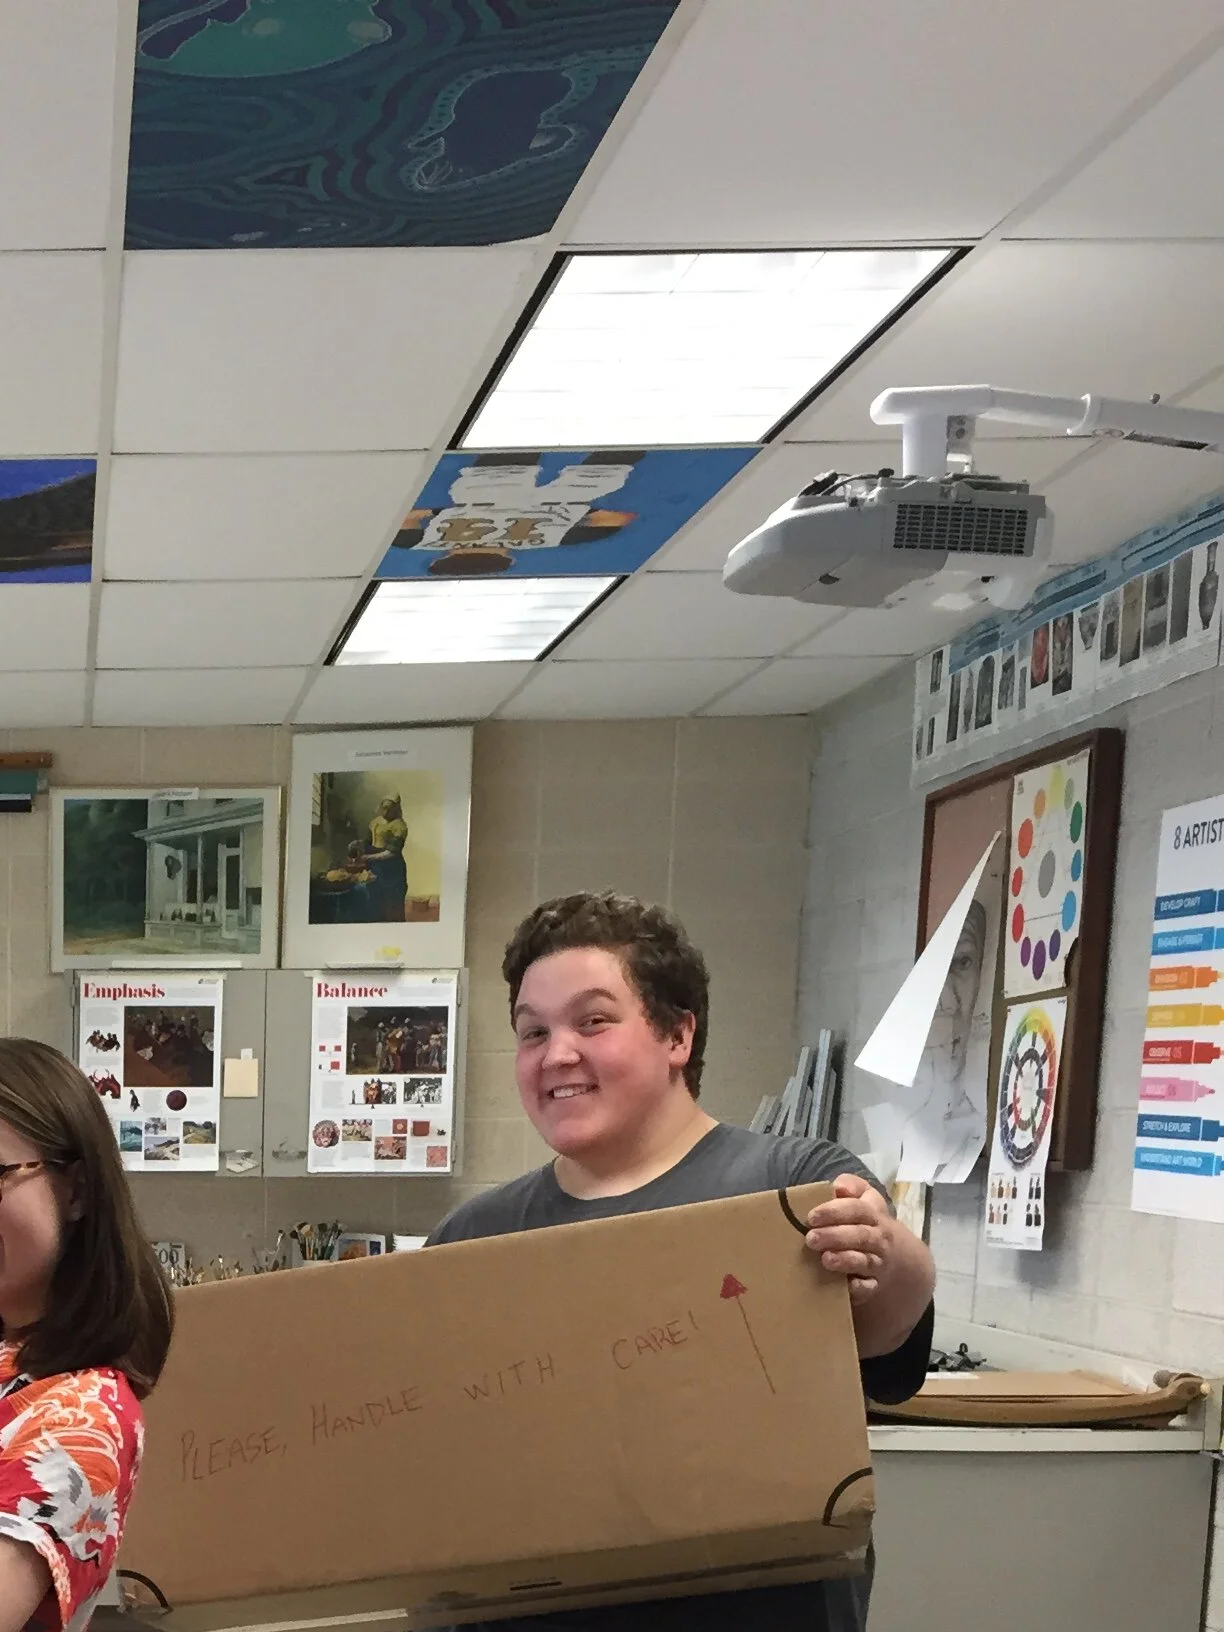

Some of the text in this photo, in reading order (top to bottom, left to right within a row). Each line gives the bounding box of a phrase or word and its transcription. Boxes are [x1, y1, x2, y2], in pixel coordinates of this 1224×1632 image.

[1173, 825, 1182, 850] 8
[83, 982, 166, 1000] Emphasis
[317, 982, 388, 998] Balance
[180, 1310, 702, 1482] PLEASE, HANDLE WITH CARE!
